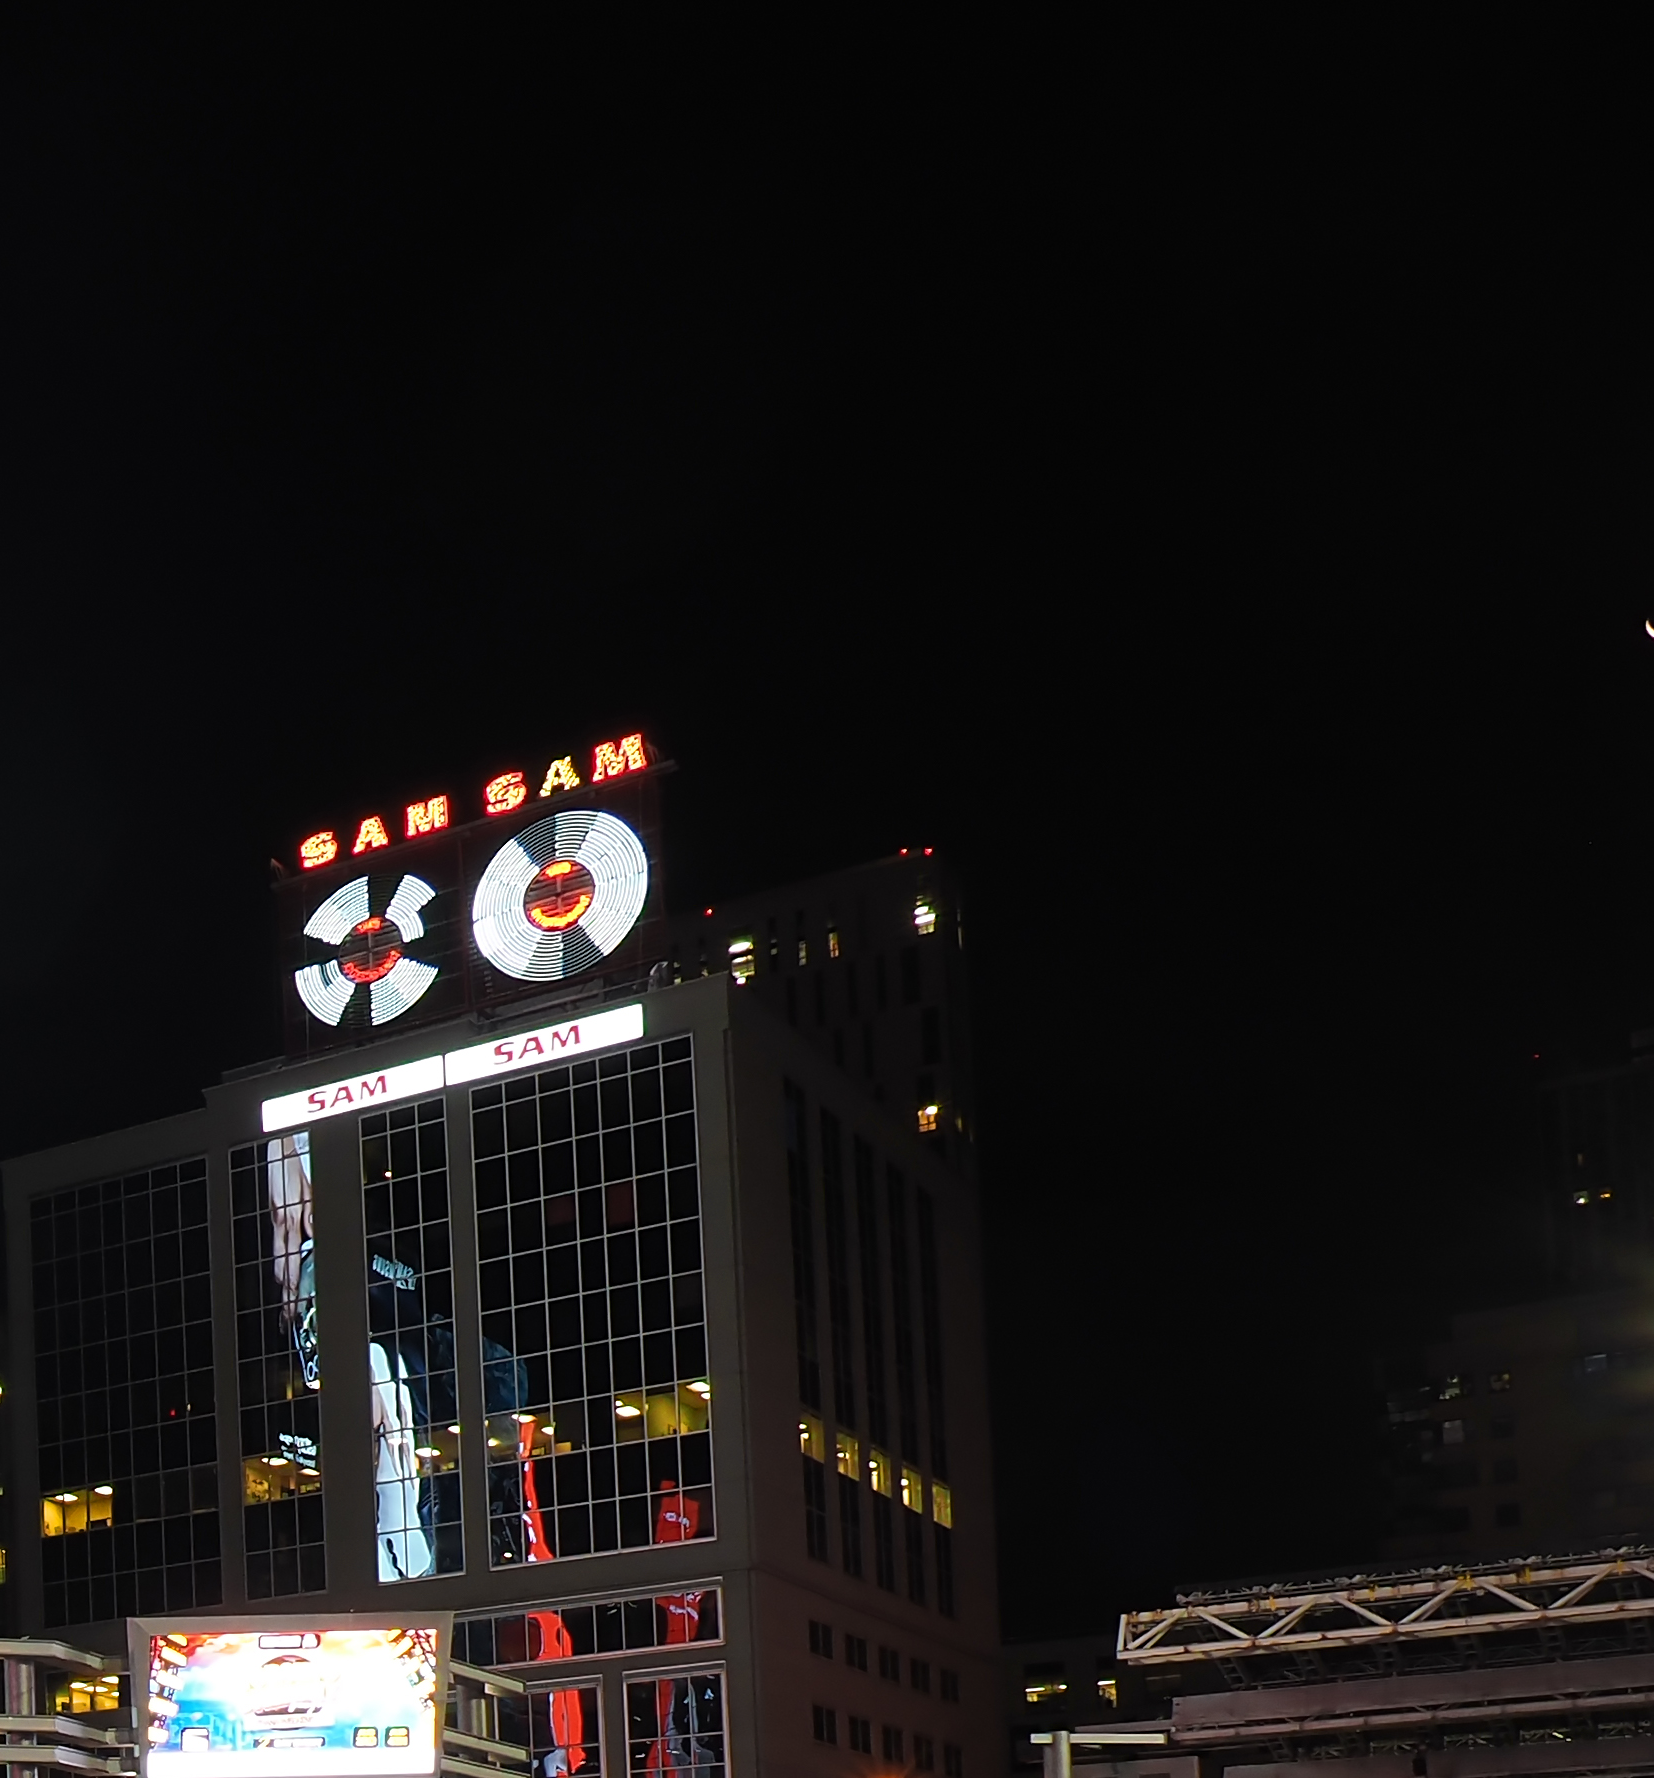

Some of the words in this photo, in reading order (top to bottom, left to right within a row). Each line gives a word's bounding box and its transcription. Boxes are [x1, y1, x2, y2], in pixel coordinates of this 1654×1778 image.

[484, 732, 649, 816] SAM
[300, 795, 450, 869] SAM
[492, 1024, 582, 1066] SAM
[307, 1074, 388, 1114] SAM
